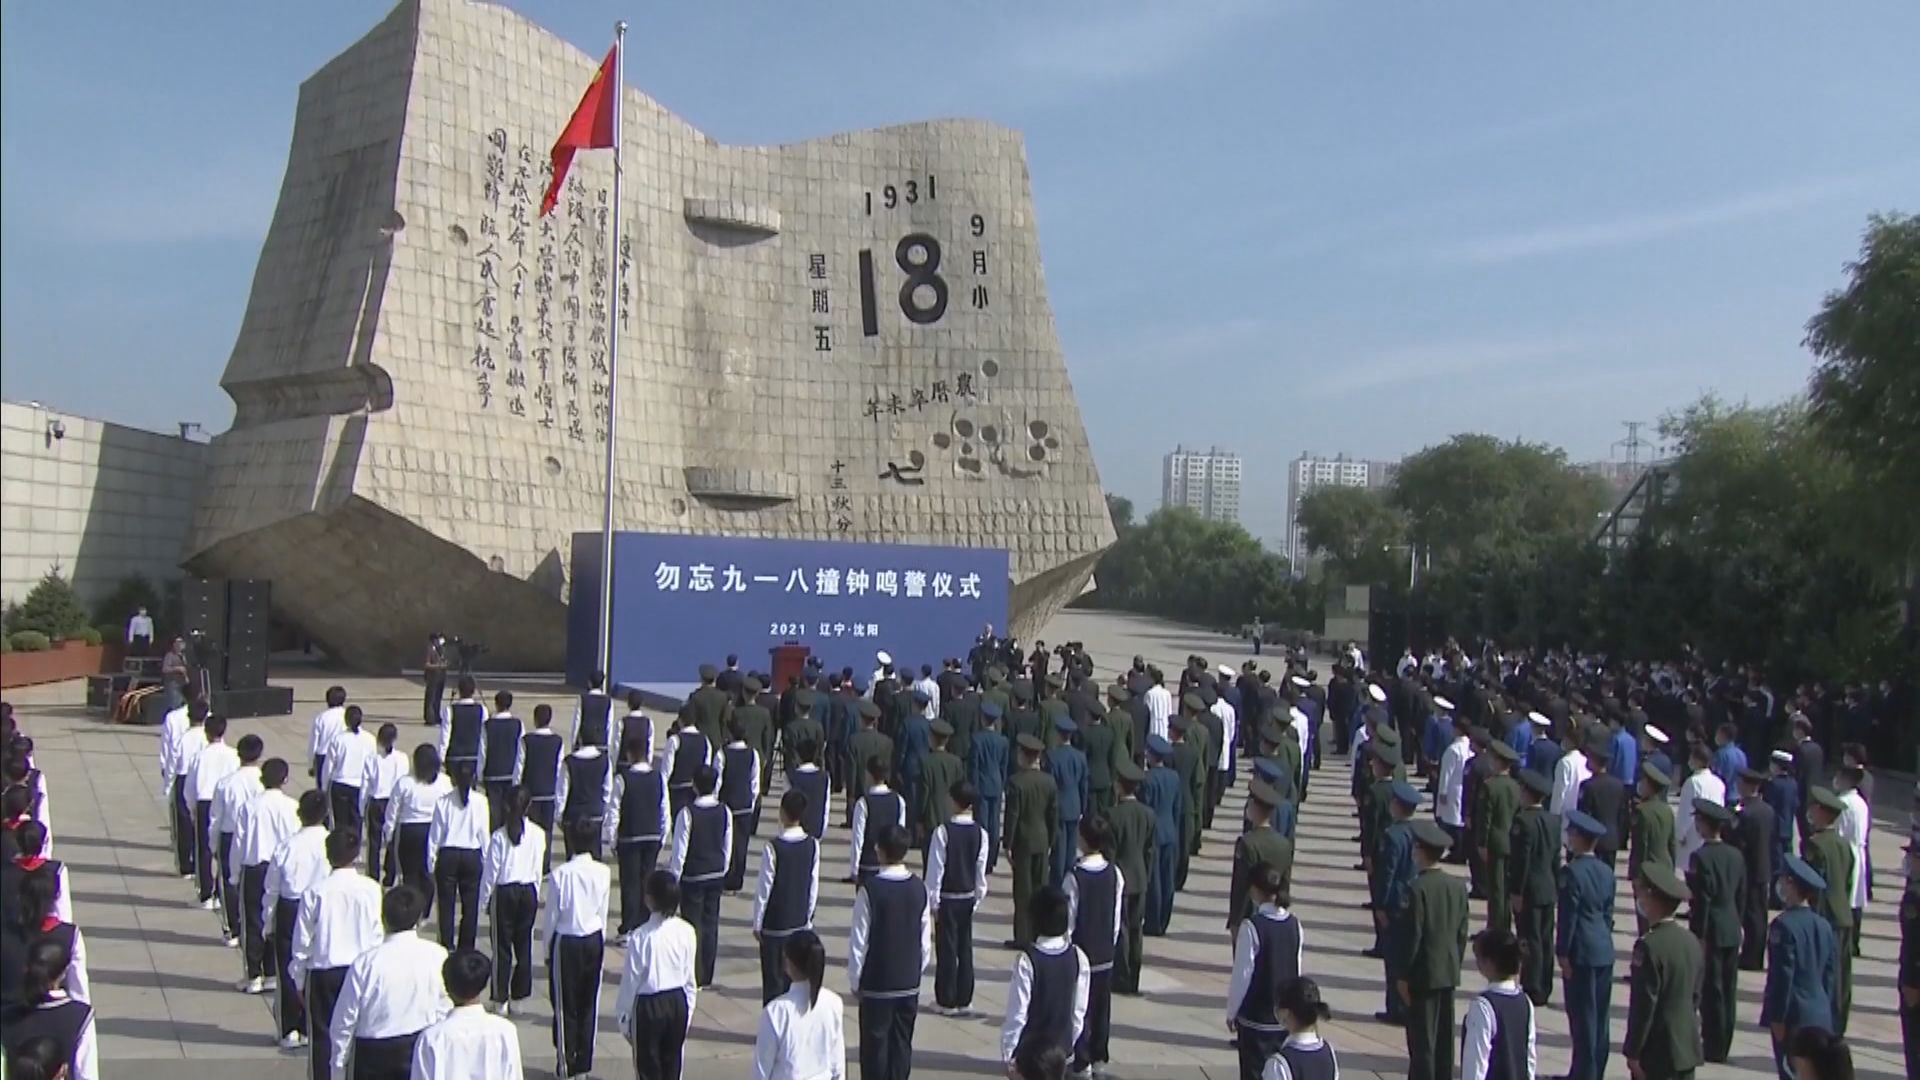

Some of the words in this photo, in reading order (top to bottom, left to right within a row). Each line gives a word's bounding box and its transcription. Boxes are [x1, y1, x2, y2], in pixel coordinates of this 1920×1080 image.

[865, 174, 936, 216] 1931
[809, 254, 832, 351] 星期五
[858, 232, 948, 337] 18
[654, 561, 981, 599] 勿忘九一八撞钟鸣警仪式
[769, 623, 806, 636] 2021
[818, 623, 879, 637] 辽宁·沈阳
